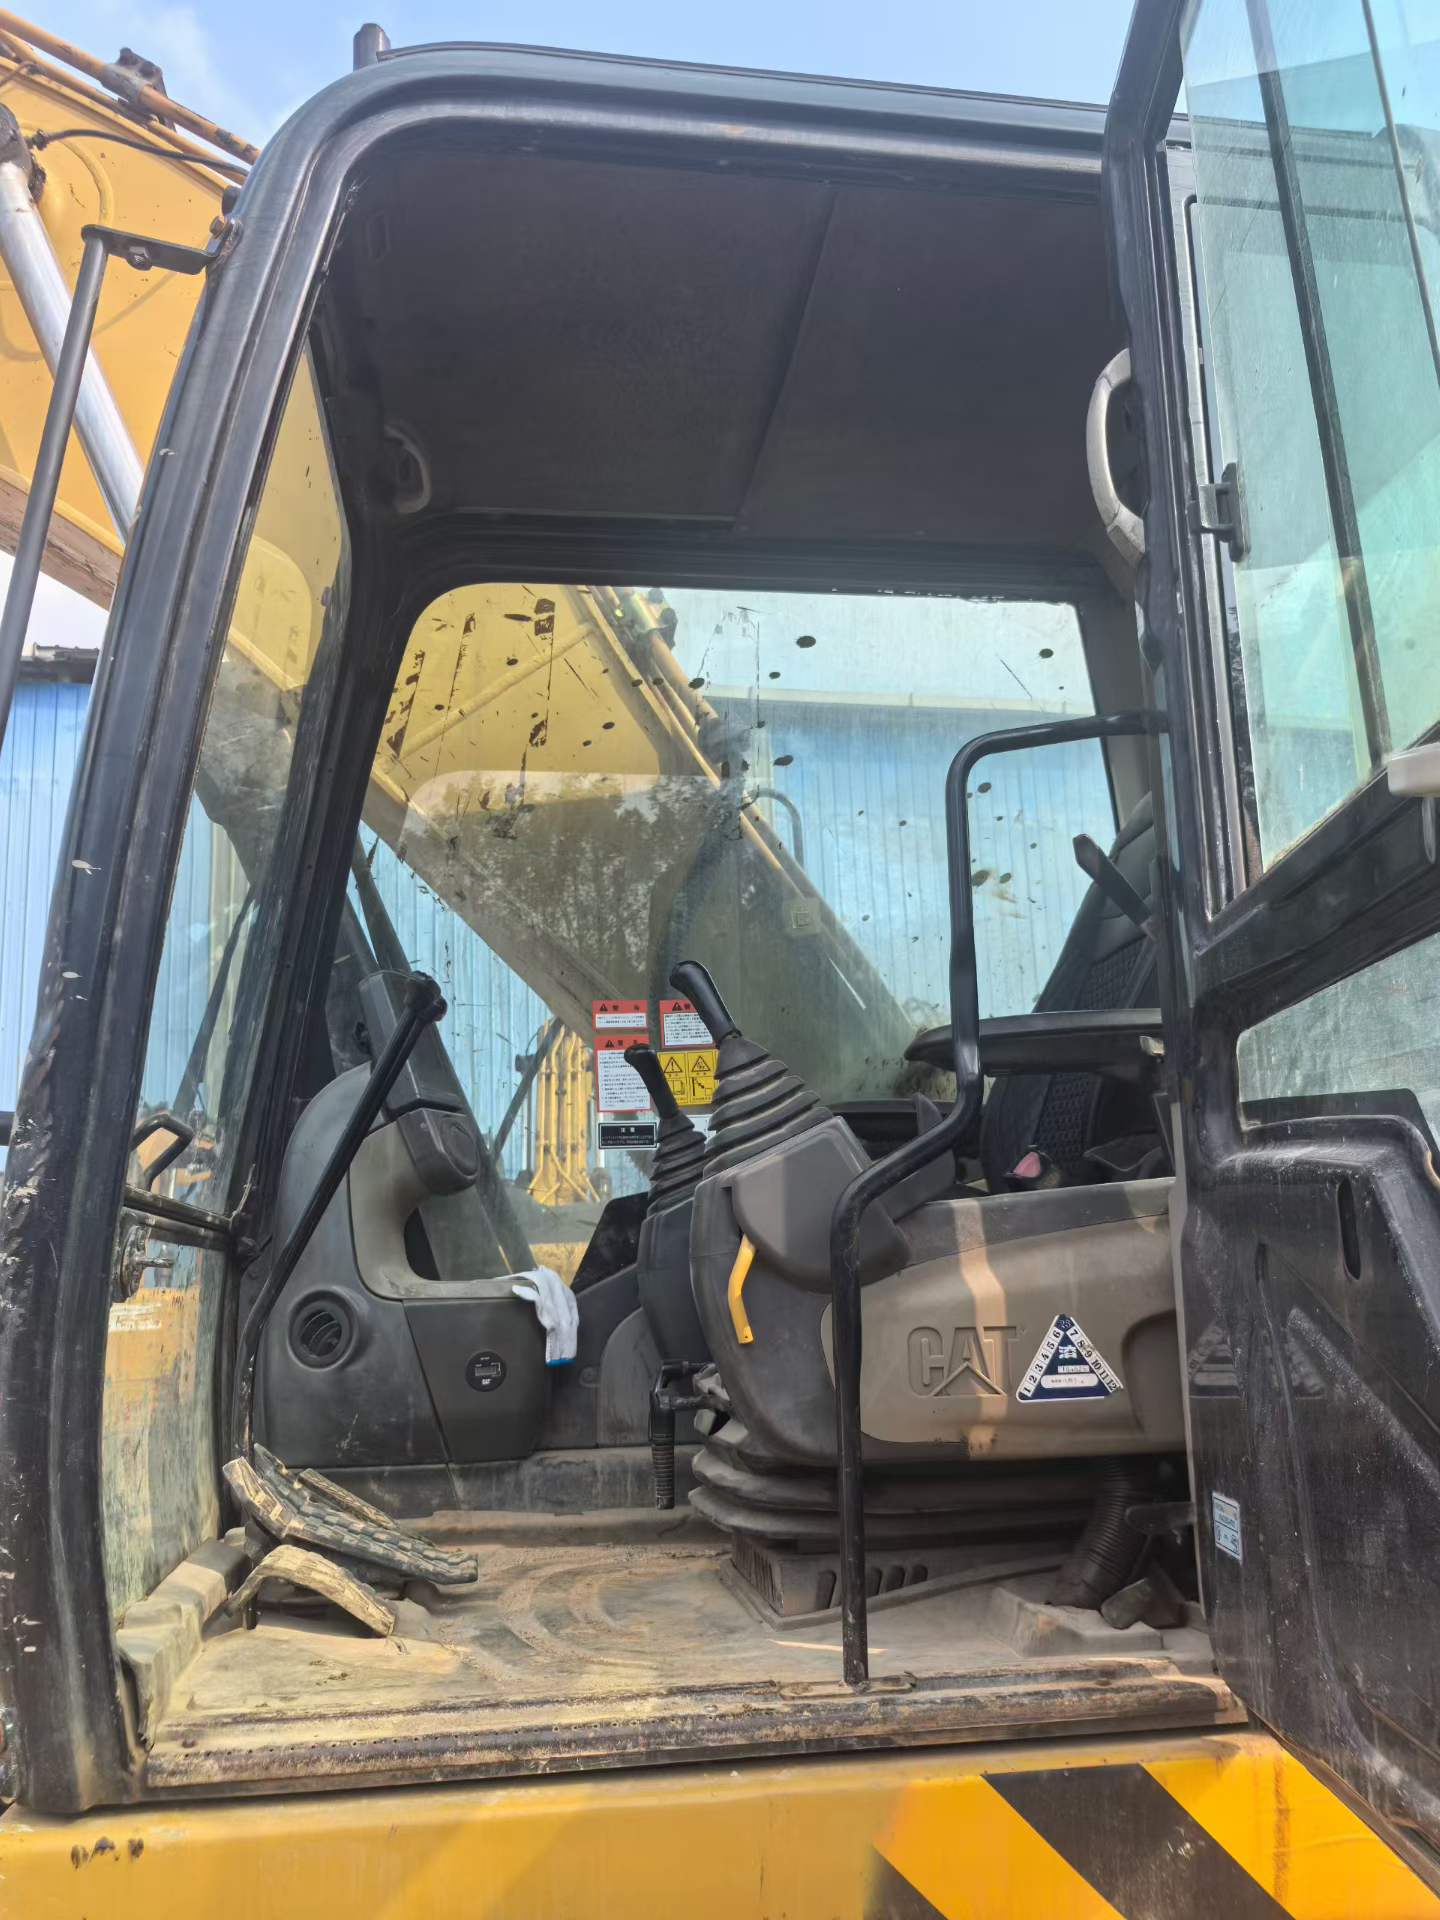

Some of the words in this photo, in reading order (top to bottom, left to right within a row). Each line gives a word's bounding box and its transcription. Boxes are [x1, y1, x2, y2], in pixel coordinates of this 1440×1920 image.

[907, 1326, 1019, 1398] CAT
[1023, 1386, 1031, 1394] 1
[1028, 1375, 1037, 1384] 2
[1035, 1363, 1043, 1372] 3
[1041, 1352, 1049, 1361] 4
[1046, 1341, 1055, 1350] 5
[1052, 1330, 1061, 1338] 6
[1070, 1329, 1079, 1337] 7
[1077, 1339, 1085, 1348] 8
[1084, 1350, 1093, 1358] 9
[1091, 1359, 1102, 1371] 10
[1099, 1370, 1110, 1381] 11
[1106, 1379, 1117, 1391] 12
